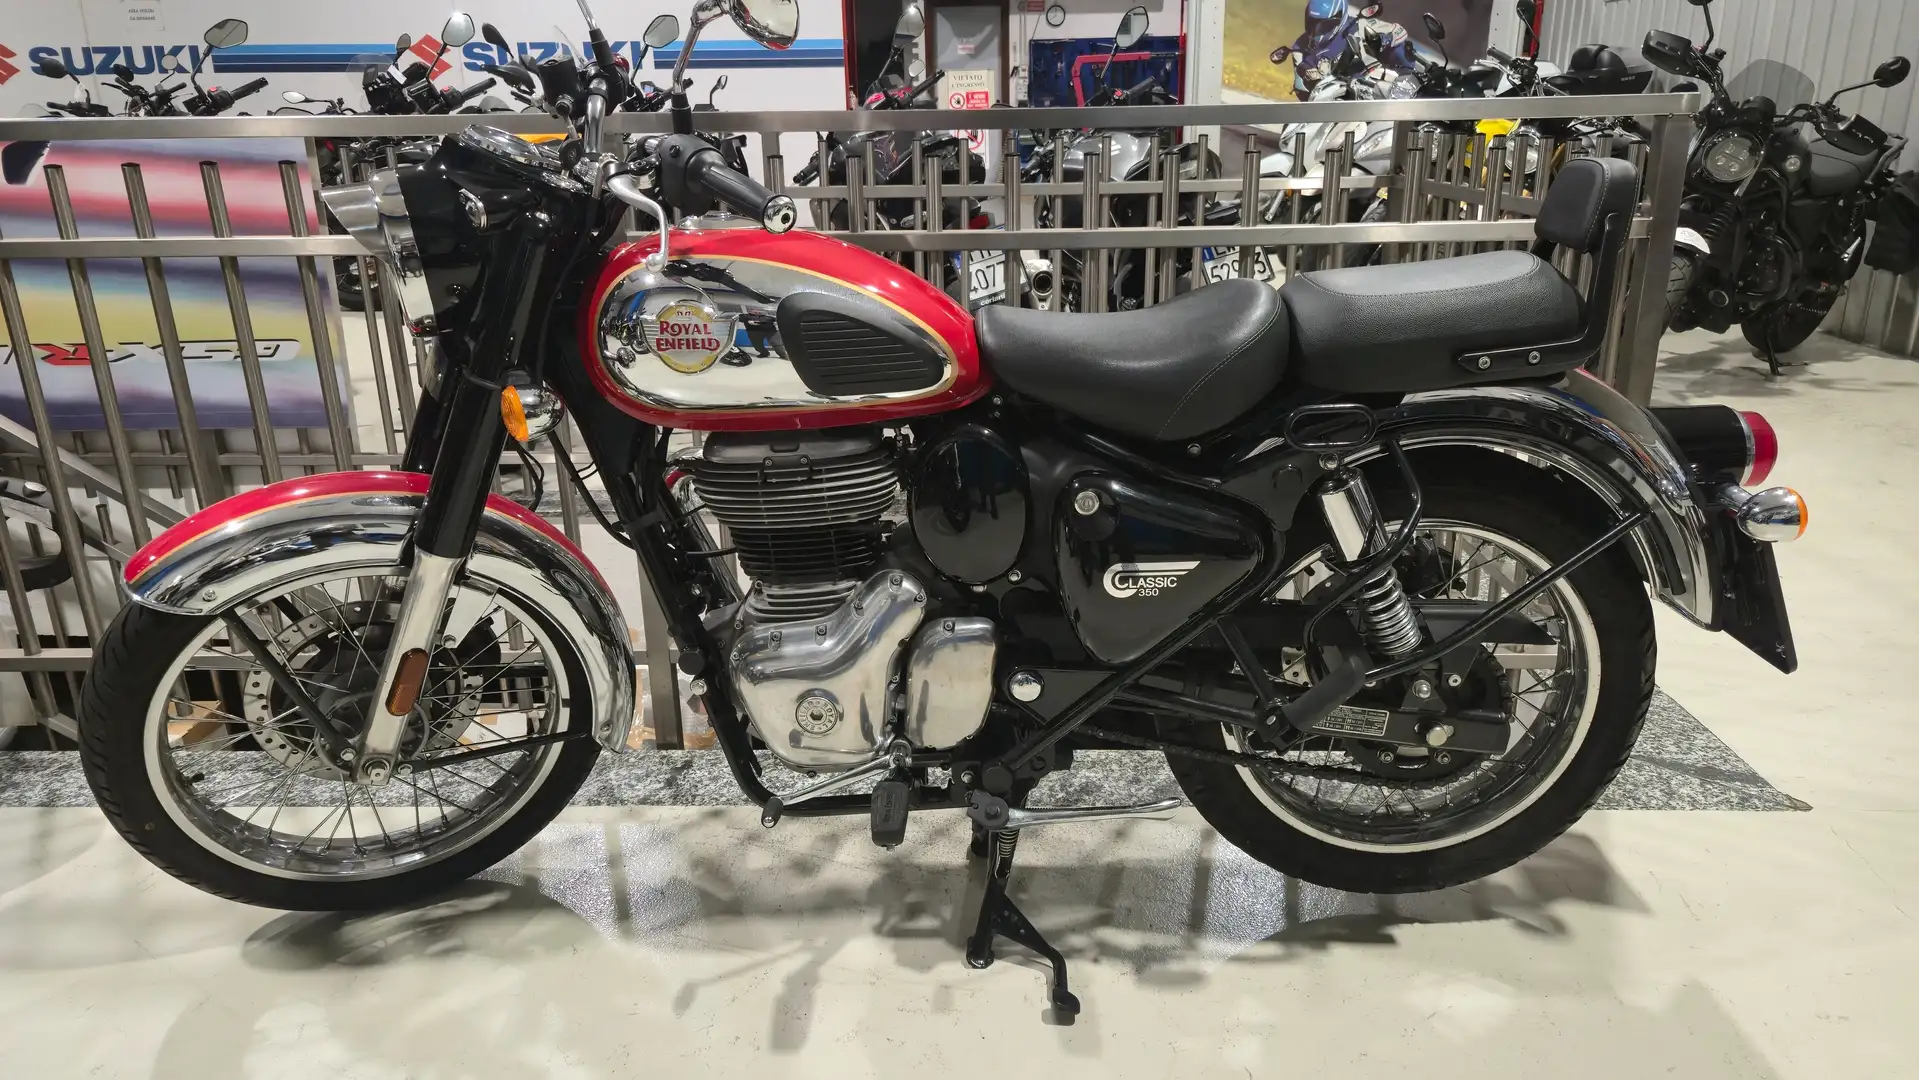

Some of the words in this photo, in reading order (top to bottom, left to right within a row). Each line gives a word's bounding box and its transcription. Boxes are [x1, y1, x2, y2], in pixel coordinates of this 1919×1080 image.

[28, 45, 203, 76] SUZUKI
[659, 320, 711, 336] ROYAL
[655, 337, 720, 352] ENFIELD
[1138, 588, 1159, 597] 350
